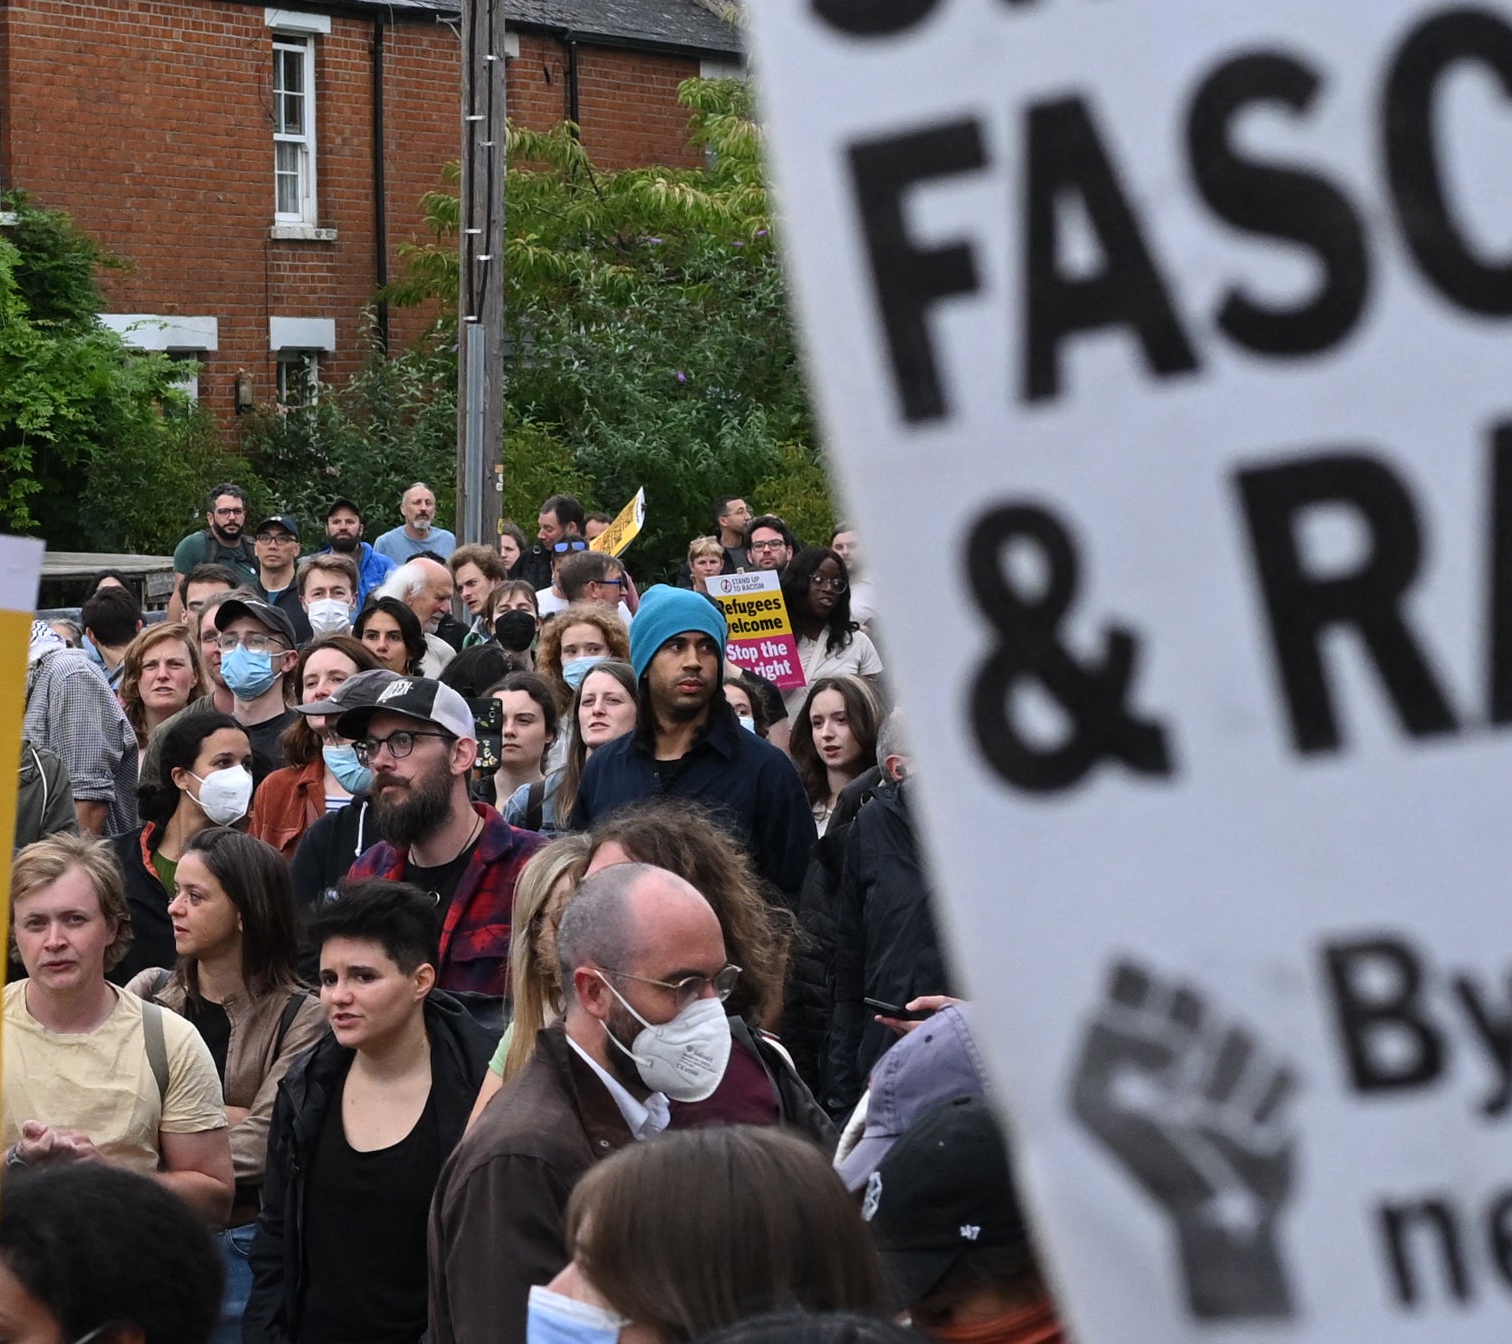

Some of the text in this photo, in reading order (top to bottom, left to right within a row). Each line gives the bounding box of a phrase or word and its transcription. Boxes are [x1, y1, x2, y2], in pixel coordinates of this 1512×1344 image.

[726, 641, 788, 663] Stop the
[959, 493, 1179, 796] &
[754, 659, 793, 681] right
